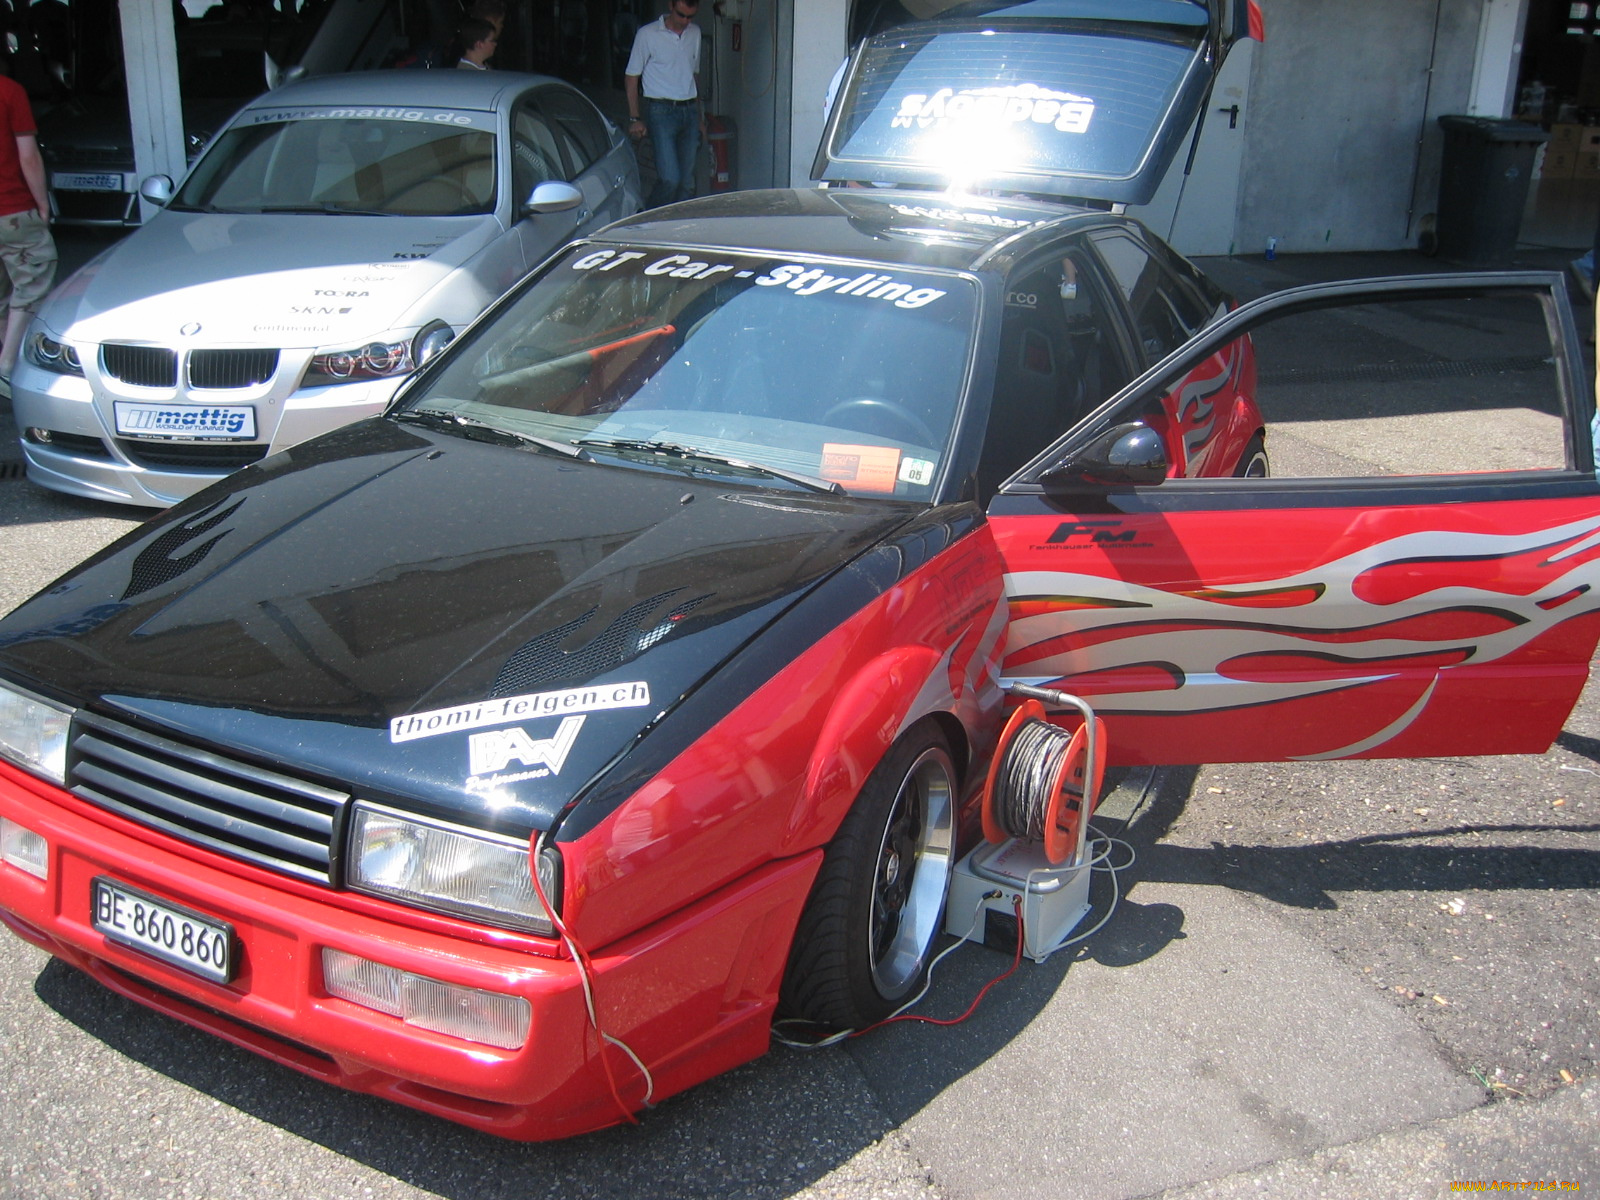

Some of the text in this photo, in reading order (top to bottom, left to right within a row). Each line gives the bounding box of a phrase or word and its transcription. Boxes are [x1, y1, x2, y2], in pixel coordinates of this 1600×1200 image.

[254, 107, 473, 125] www.mattig.de
[572, 250, 647, 271] GT
[644, 254, 734, 280] Car
[754, 264, 948, 309] Styling
[1005, 291, 1037, 305] rco
[156, 409, 246, 433] mattig
[909, 470, 922, 480] 05
[395, 684, 646, 736] thomi-felgen.ch
